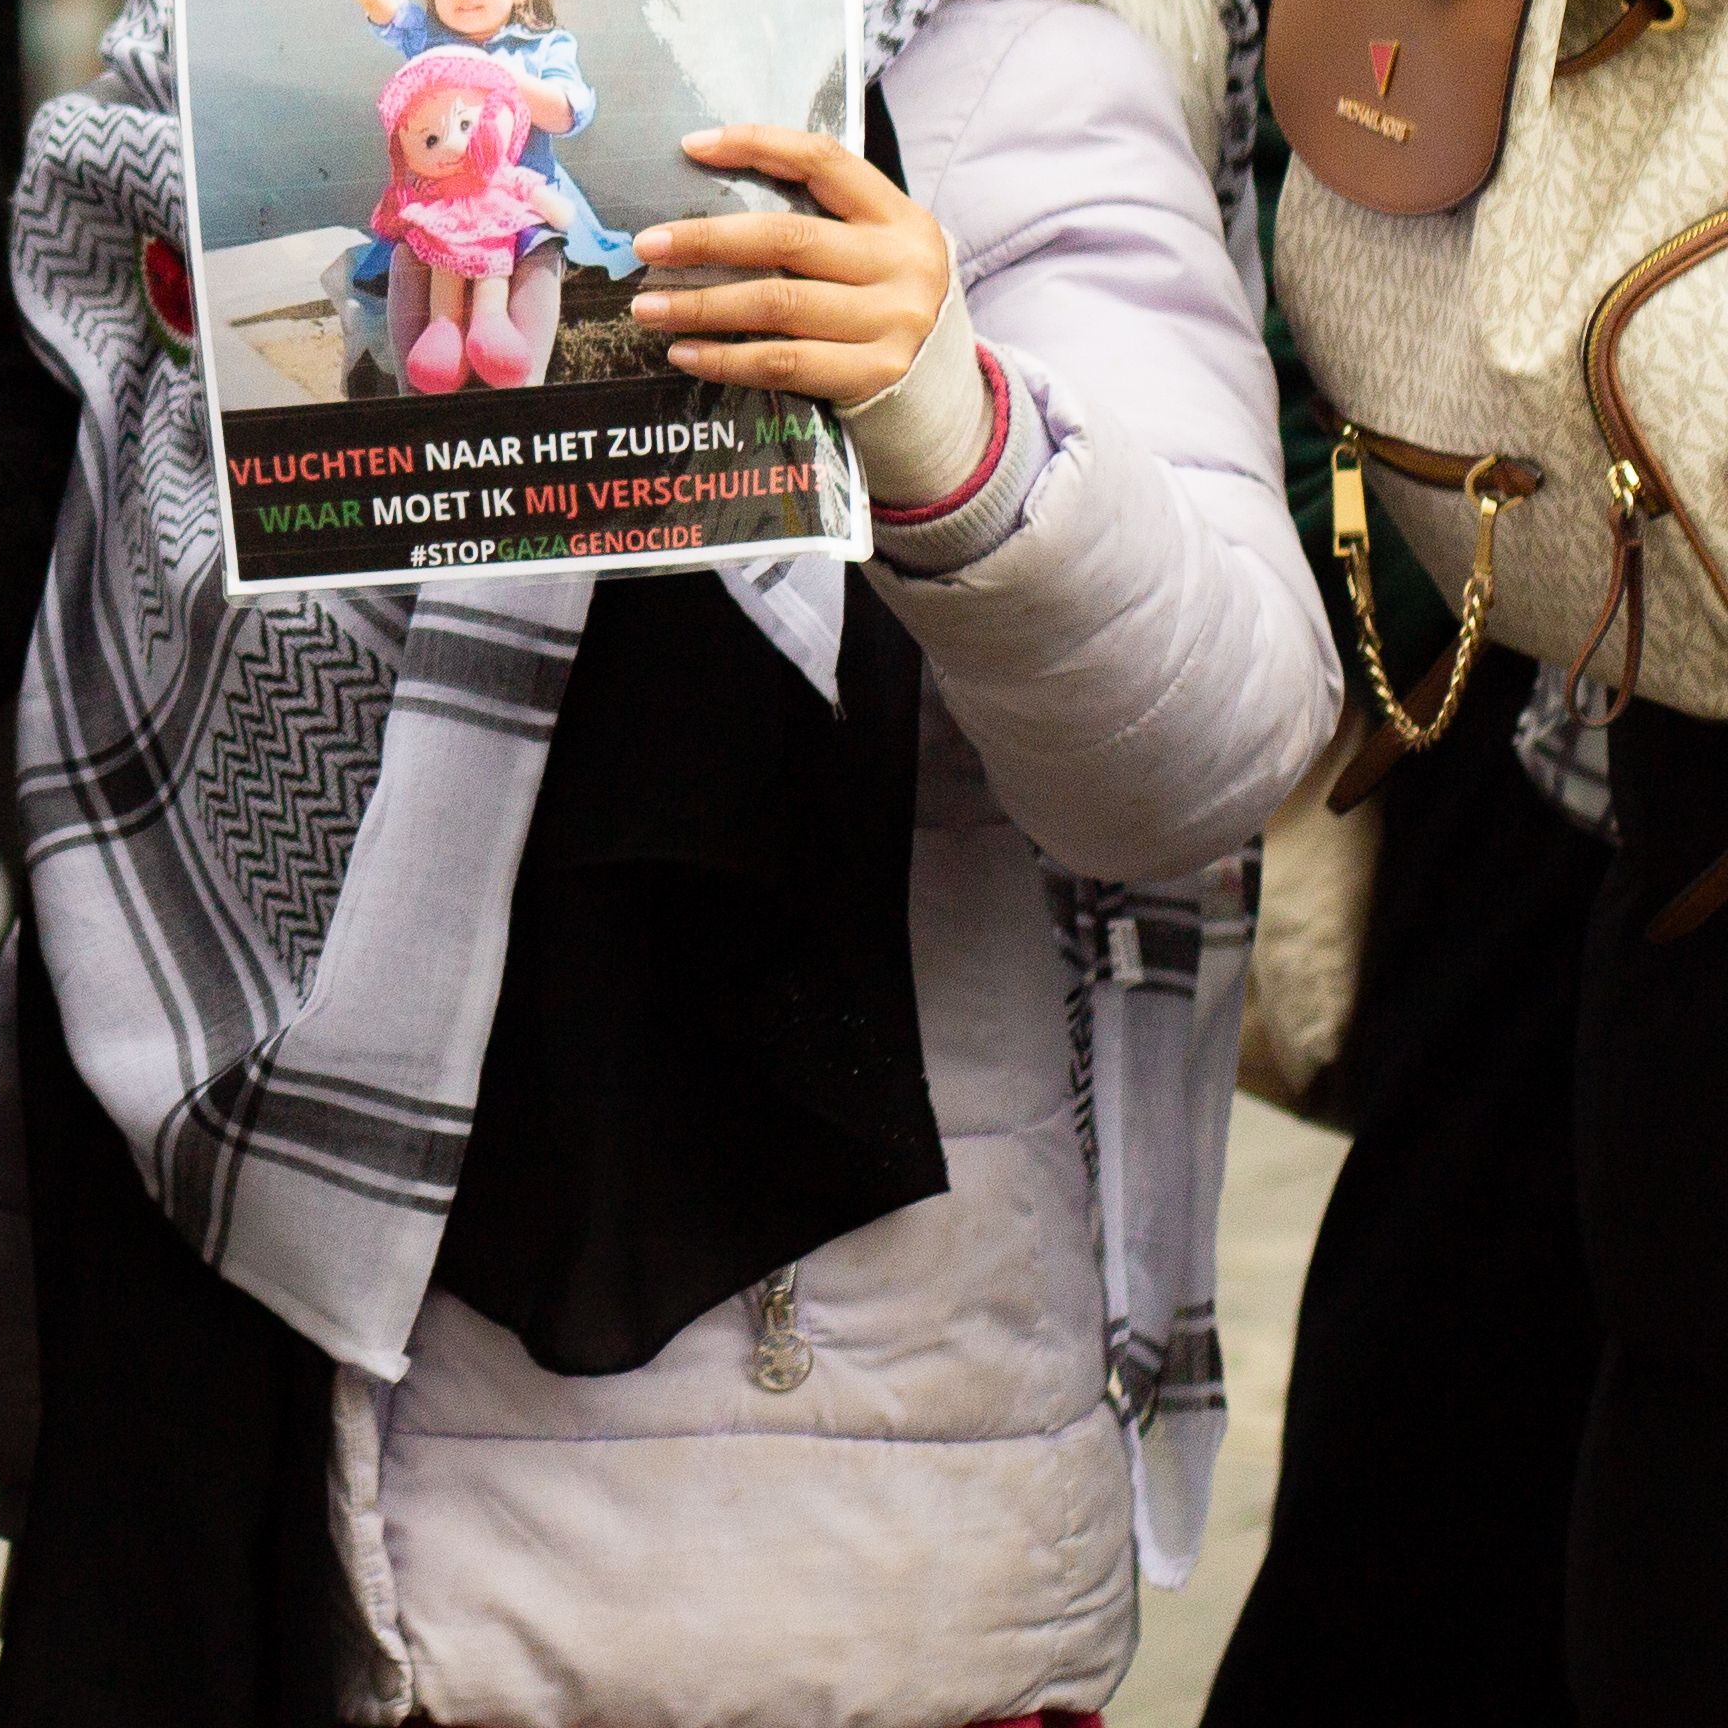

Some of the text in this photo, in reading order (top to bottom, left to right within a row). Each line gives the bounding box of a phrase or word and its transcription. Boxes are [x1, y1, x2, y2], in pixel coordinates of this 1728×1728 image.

[230, 445, 415, 487] VLUCHTEN
[424, 434, 524, 472] NAAR
[533, 430, 599, 464] HET
[607, 418, 745, 460] ZUIDEN,
[258, 463, 828, 534] WAAR MOET IK MIJ VERSCHUILEN?
[410, 523, 704, 568] #STOPGAZAGENOCIDE
